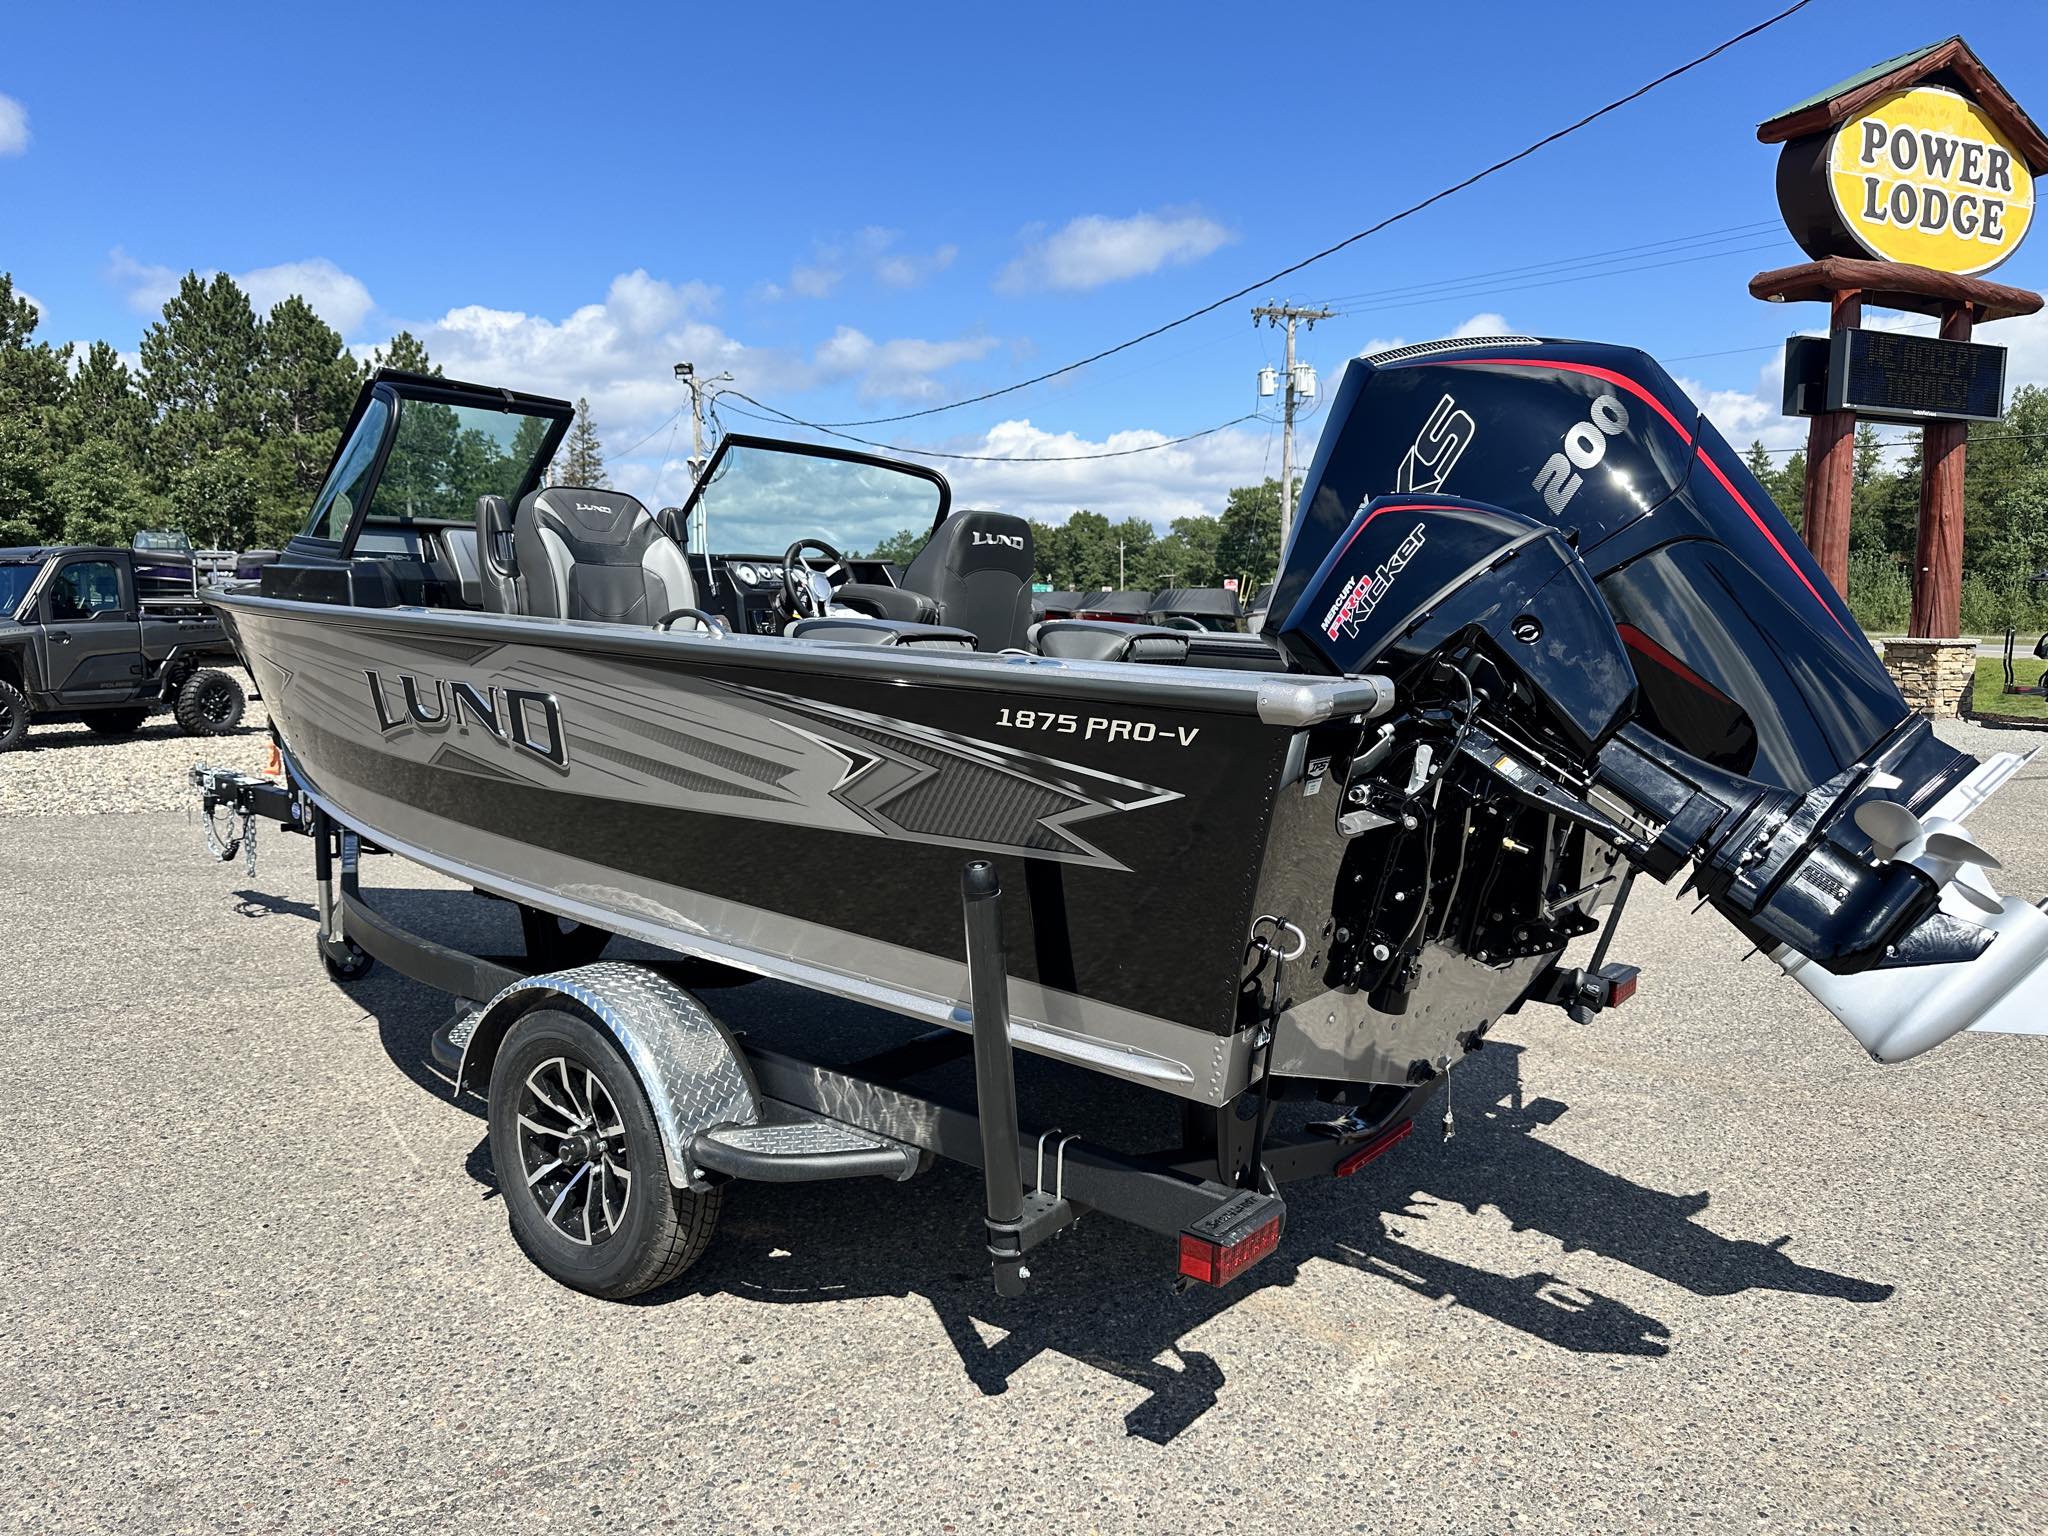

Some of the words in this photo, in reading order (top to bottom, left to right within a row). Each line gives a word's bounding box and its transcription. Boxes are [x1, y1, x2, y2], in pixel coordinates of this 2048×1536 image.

[1861, 121, 2012, 191] POWER
[1863, 177, 2004, 241] LODGE
[1531, 394, 1629, 516] 200
[575, 502, 612, 514] LUND
[972, 531, 1024, 550] LUND
[1320, 575, 1356, 632] MERCURY
[1327, 574, 1372, 642] PRO
[362, 668, 570, 771] LUND
[995, 708, 1079, 734] 1875
[1084, 717, 1200, 747] PRO-V
